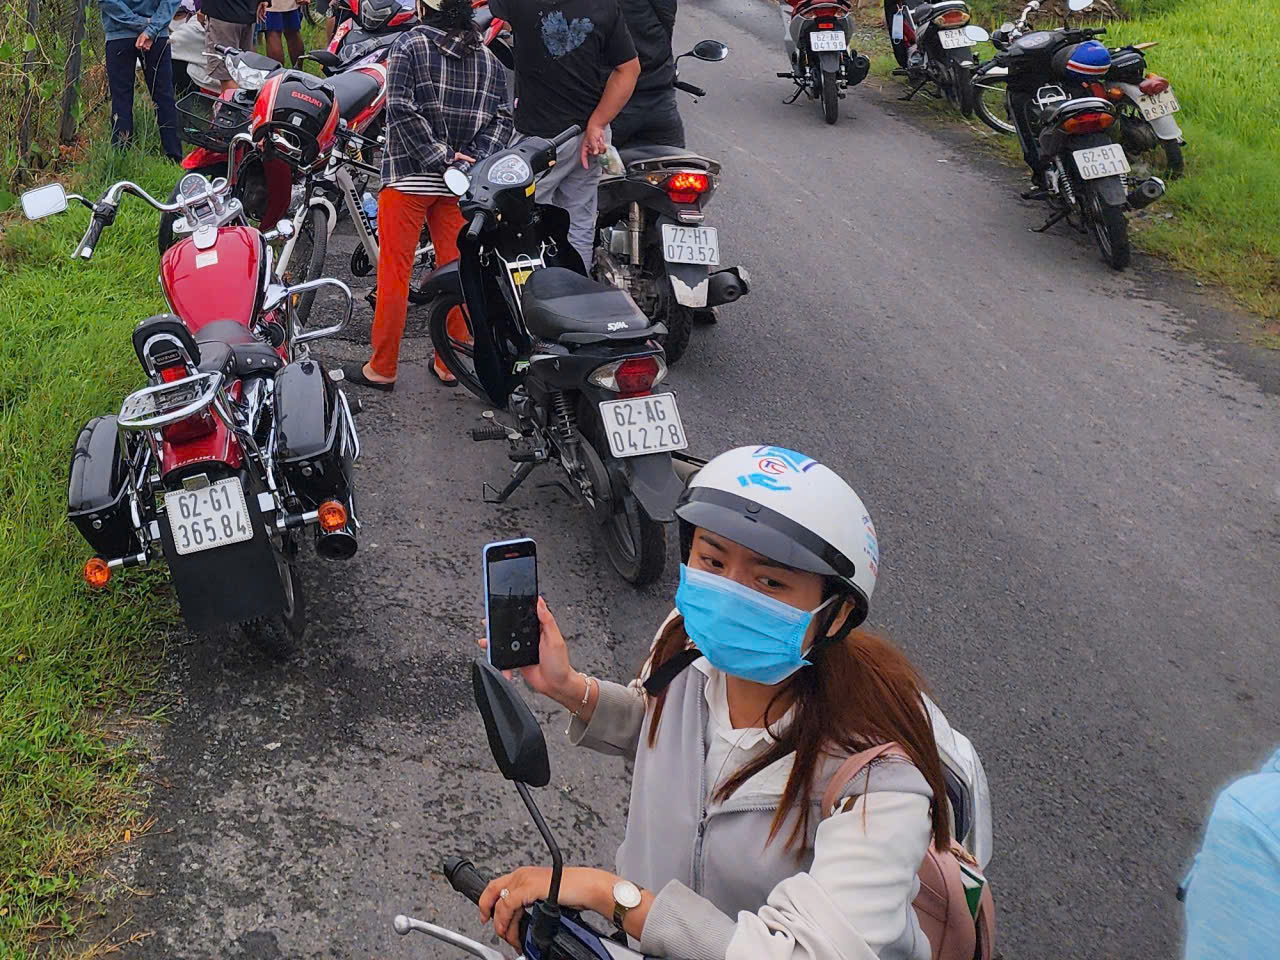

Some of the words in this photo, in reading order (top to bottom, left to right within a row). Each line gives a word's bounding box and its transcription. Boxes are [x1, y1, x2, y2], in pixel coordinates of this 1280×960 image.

[291, 91, 323, 108] SUZUKI
[1082, 148, 1116, 163] 62-B1
[1082, 160, 1126, 177] 003.11
[671, 228, 708, 245] 72-H1
[667, 245, 716, 262] 073.52
[607, 321, 629, 331] SYM
[613, 400, 666, 426] 62-AG
[612, 424, 681, 452] 042.28
[178, 485, 232, 519] 62-G1
[177, 511, 247, 548] 365.84
